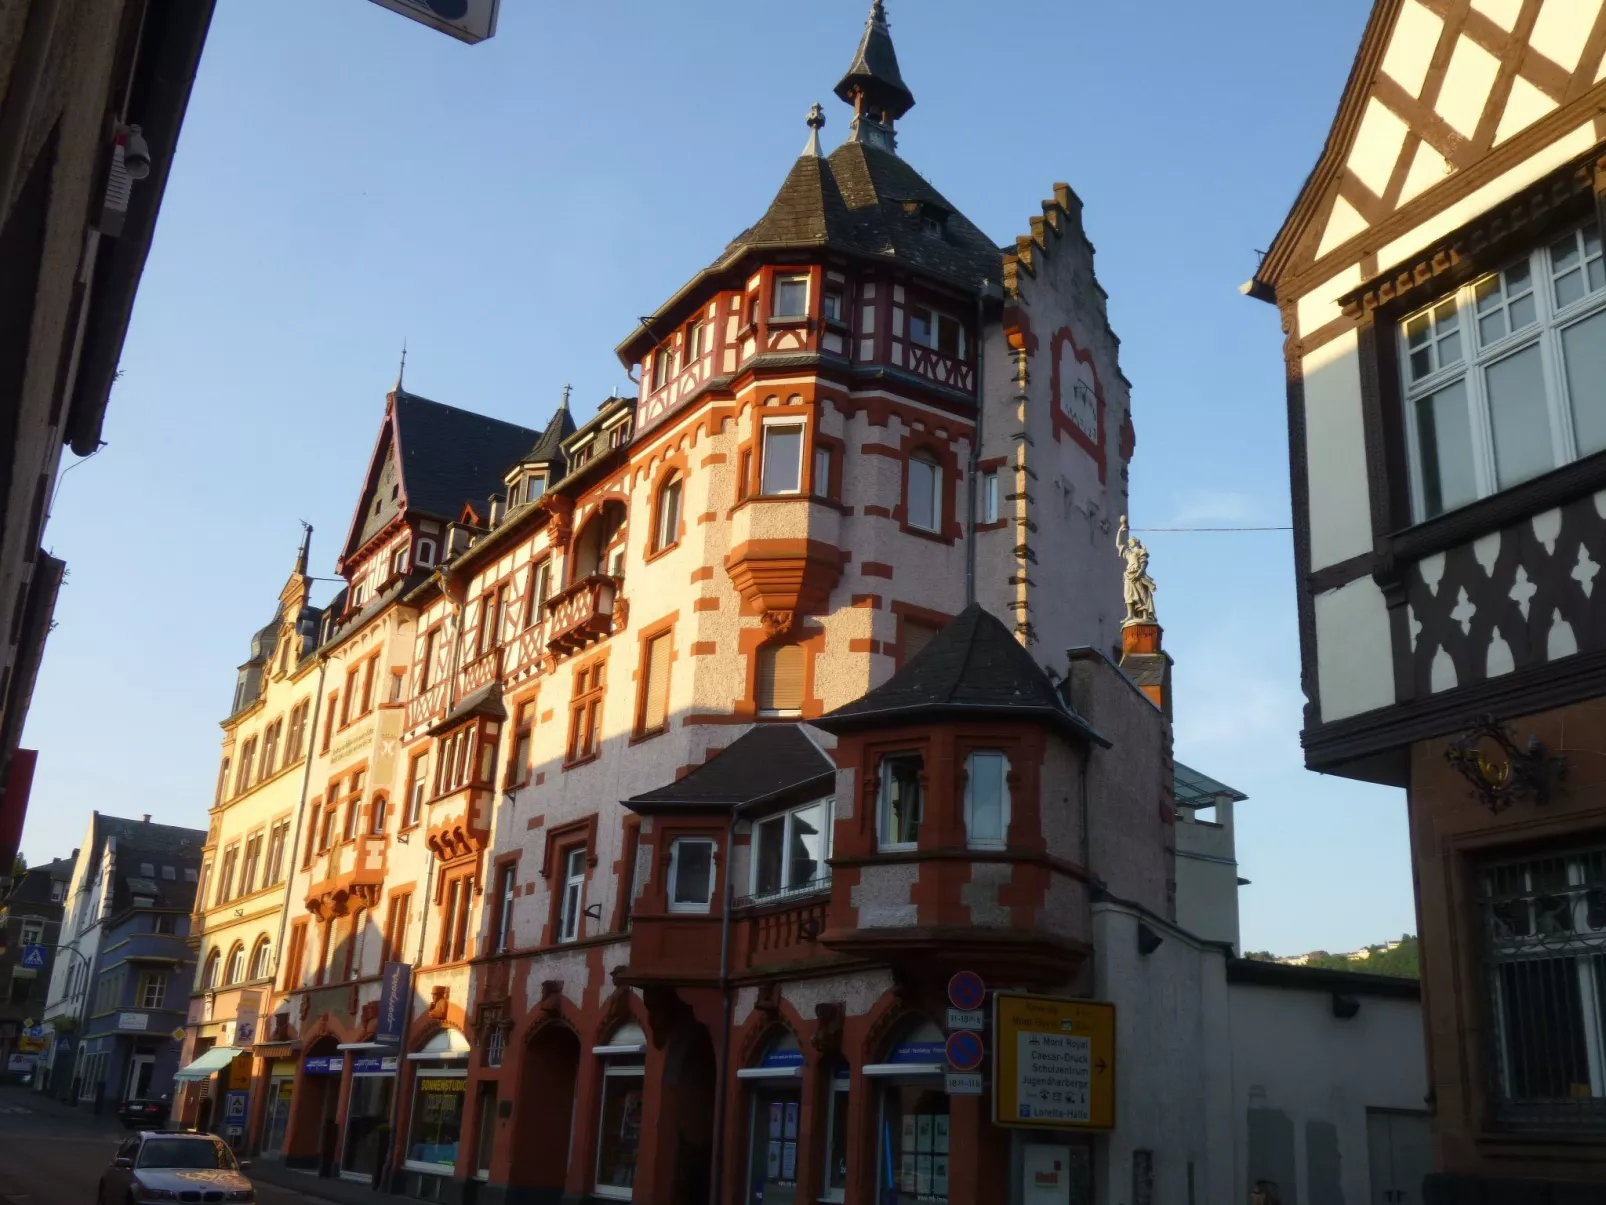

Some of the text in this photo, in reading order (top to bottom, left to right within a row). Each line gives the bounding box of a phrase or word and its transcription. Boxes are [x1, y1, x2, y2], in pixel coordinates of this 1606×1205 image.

[1043, 1036, 1088, 1051] Mont Royal
[1031, 1050, 1088, 1063] Caesar-Druck
[1032, 1063, 1088, 1076] Schulzentrum
[1022, 1075, 1088, 1090] Jugendherberge
[1033, 1107, 1088, 1119] Loretta-Halle
